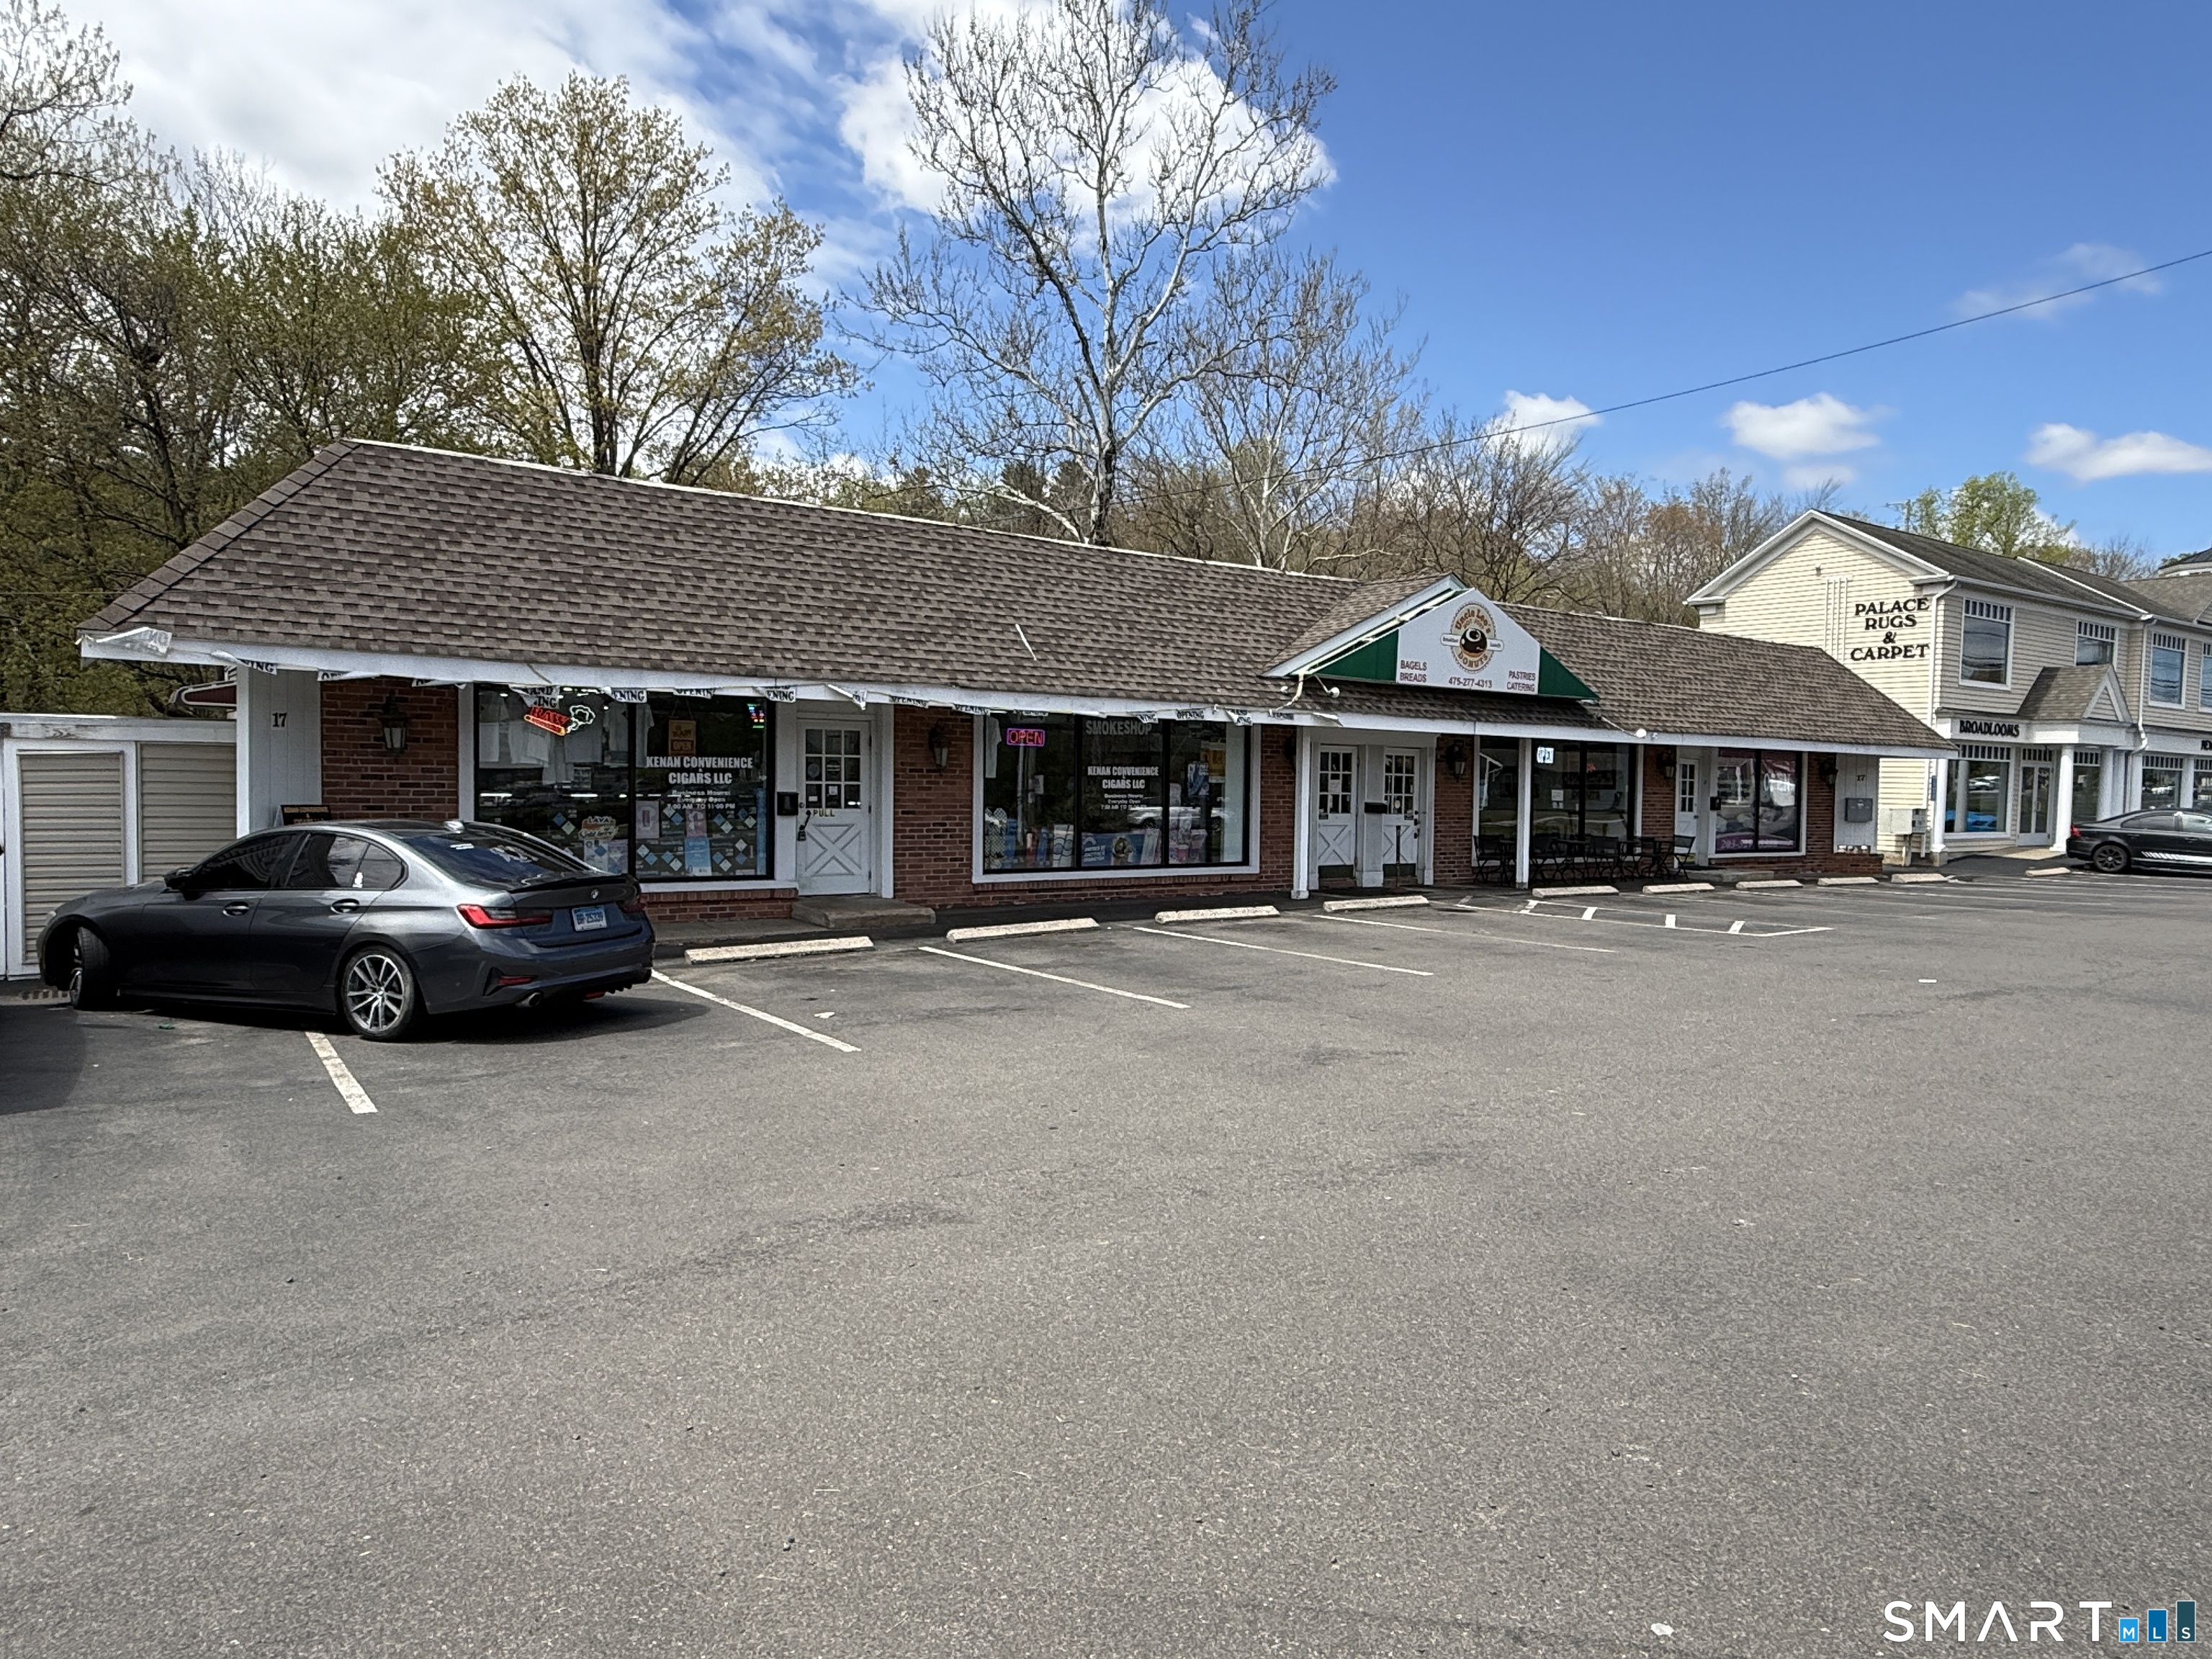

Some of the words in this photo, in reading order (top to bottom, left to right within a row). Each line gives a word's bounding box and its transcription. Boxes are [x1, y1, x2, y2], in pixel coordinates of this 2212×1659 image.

[1855, 598, 1930, 615] PALACE
[1455, 608, 1475, 629] Uncle
[1865, 614, 1917, 630] RUGS
[1883, 631, 1897, 644] &
[1851, 644, 1930, 661] CARPET
[1401, 660, 1427, 671] BAGELS
[1458, 652, 1488, 668] DONUTS
[1400, 673, 1427, 683] BREADS
[1509, 670, 1536, 681] PASTRIES
[1449, 677, 1493, 688] 475-277-4313
[1506, 682, 1535, 692] CATERING
[273, 712, 287, 727] 17
[1086, 720, 1152, 735] SMOKESHOP
[1959, 720, 2020, 737] BROADLOOMS
[1009, 730, 1043, 745] OPEN
[673, 741, 692, 750] OPEN
[647, 757, 680, 768] KENAN
[683, 757, 753, 768] CONVENIENCE
[1087, 766, 1111, 775] KENAN
[1112, 766, 1159, 776] CONVENIENCE
[668, 773, 711, 784] CIGARS
[714, 773, 732, 784] LLC
[1102, 779, 1131, 789] CIGARS
[1133, 780, 1146, 789] LLC
[813, 809, 835, 817] PULL
